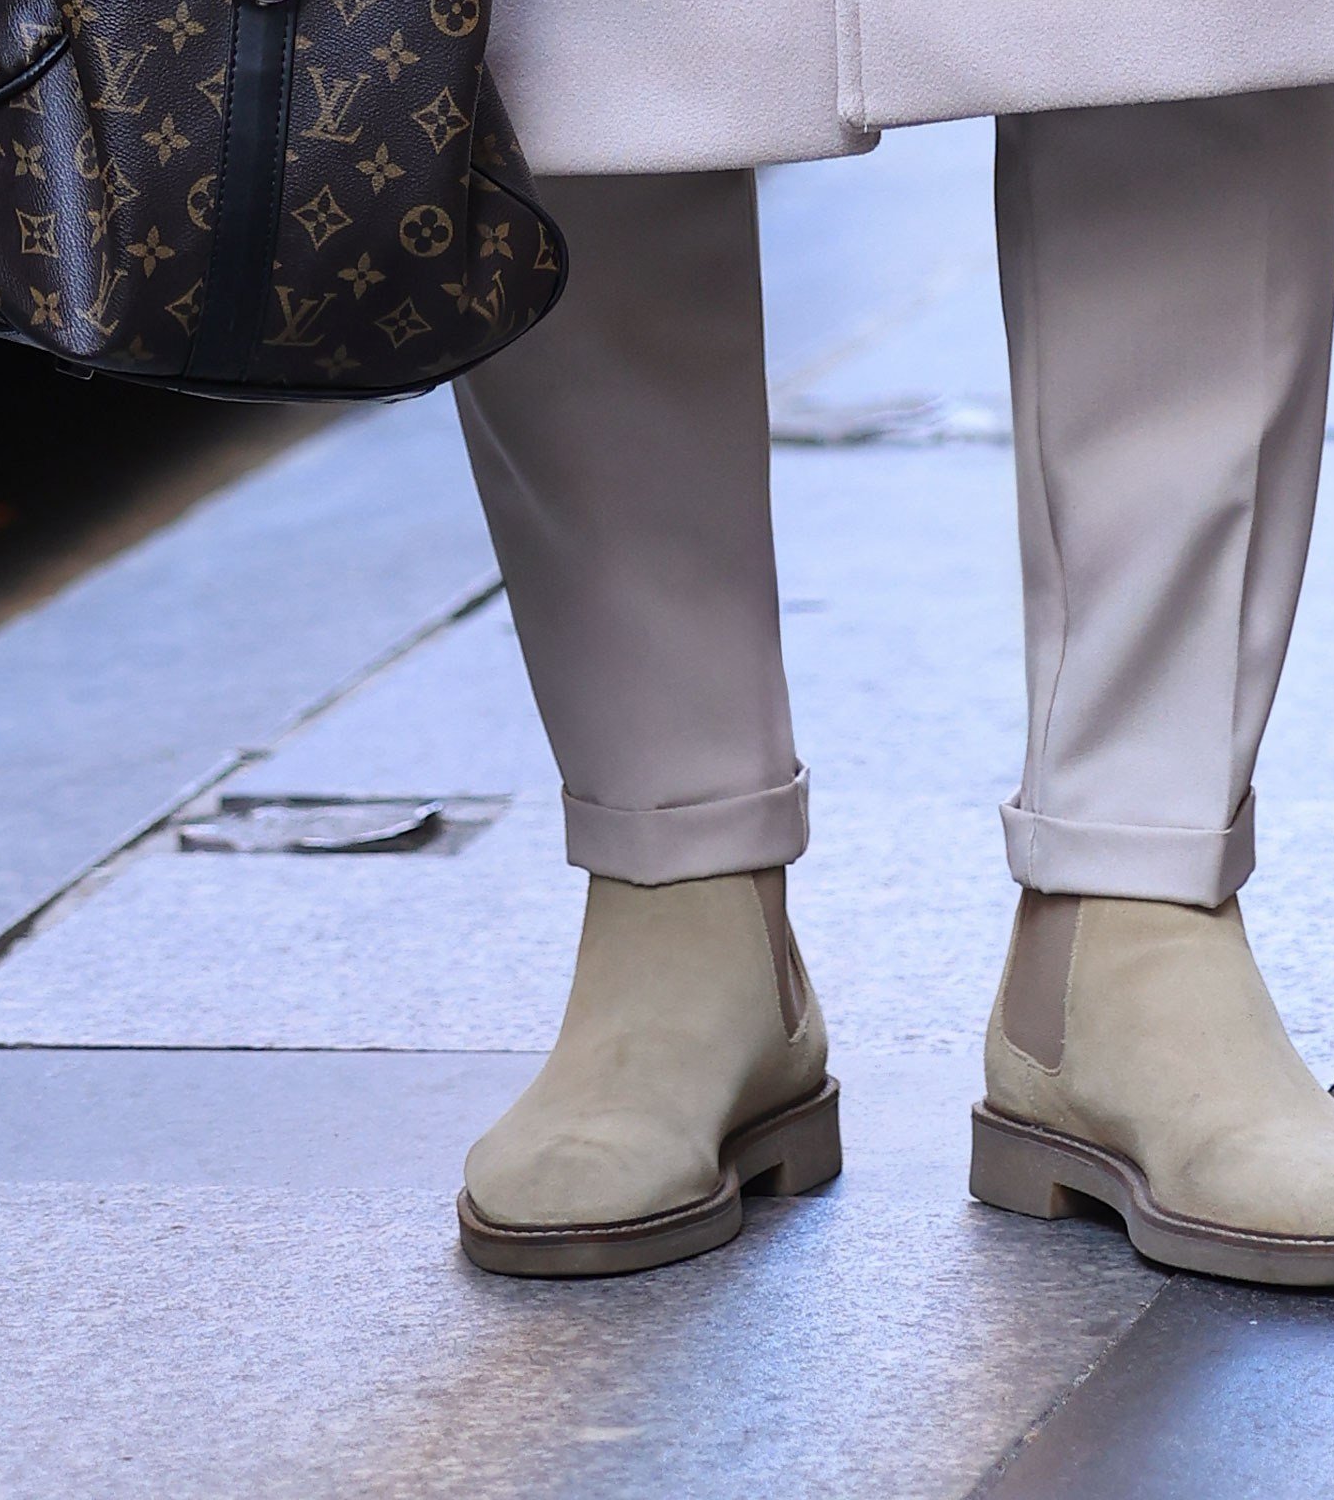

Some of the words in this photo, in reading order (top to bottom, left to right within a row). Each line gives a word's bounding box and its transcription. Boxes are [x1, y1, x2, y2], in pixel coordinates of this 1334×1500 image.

[90, 38, 158, 115] LV
[300, 66, 369, 143] LV
[263, 286, 337, 347] LV
